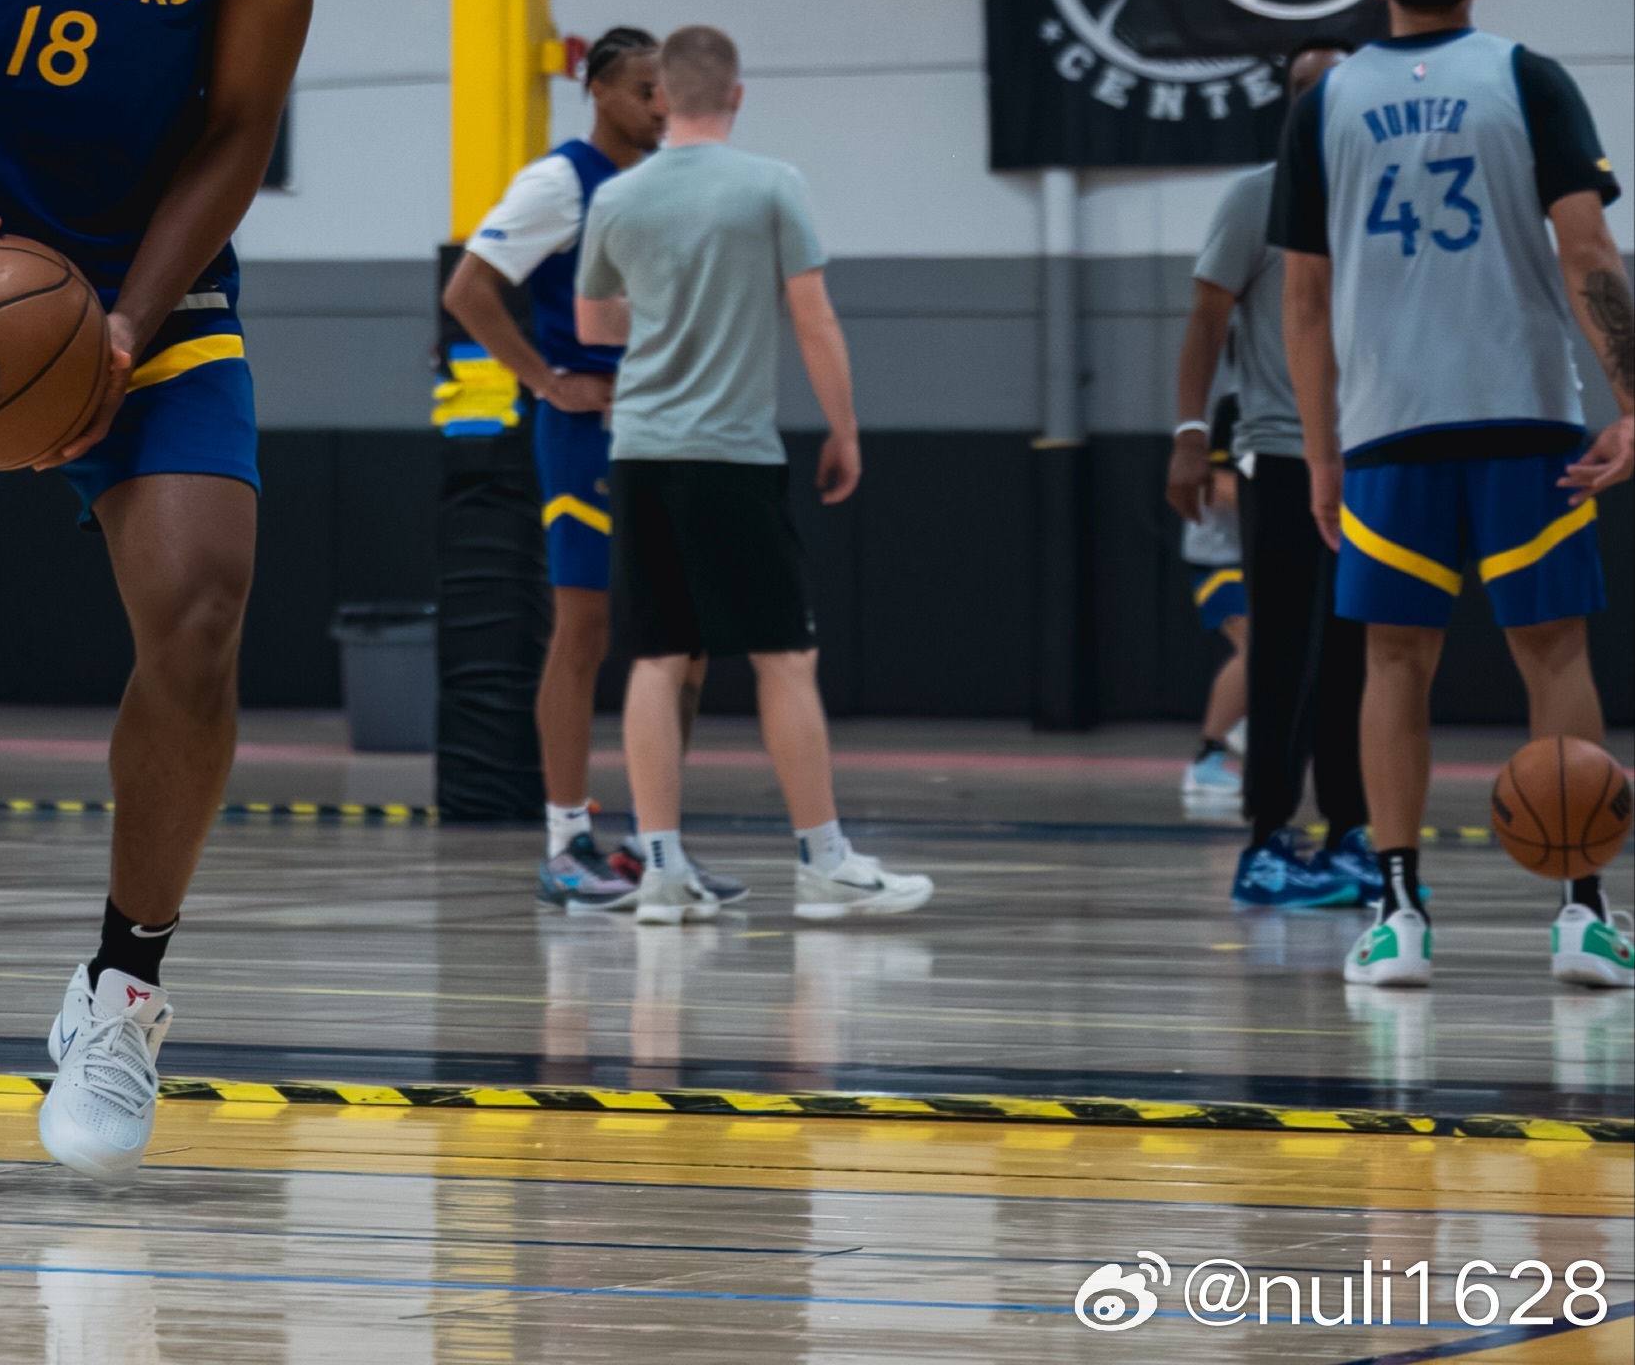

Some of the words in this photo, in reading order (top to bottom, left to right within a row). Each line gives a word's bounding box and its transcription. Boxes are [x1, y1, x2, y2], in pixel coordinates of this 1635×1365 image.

[5, 4, 98, 87] 18
[1055, 43, 1286, 120] CENTE
[1362, 97, 1468, 145] HUNTER
[1366, 155, 1483, 257] 43
